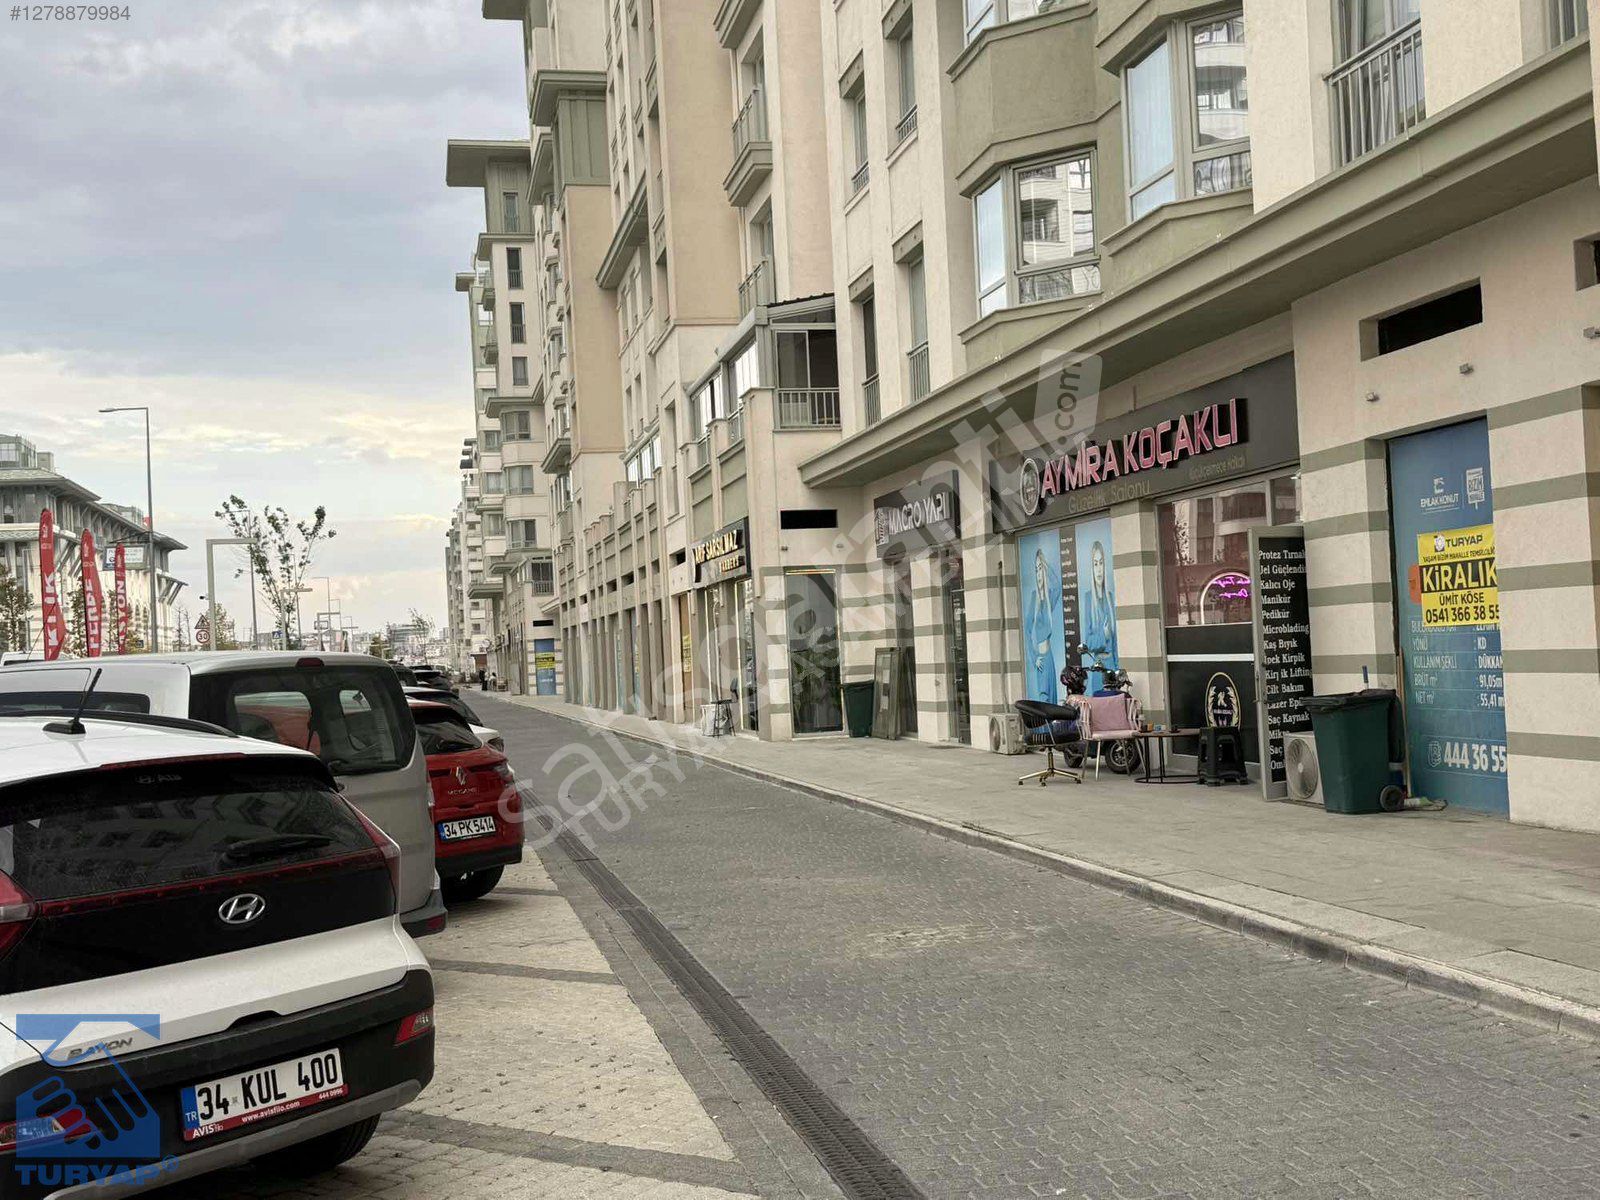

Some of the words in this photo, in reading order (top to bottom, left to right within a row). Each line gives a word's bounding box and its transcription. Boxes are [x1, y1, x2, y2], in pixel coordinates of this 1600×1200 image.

[1041, 440, 1119, 498] AYMİRA
[1123, 399, 1238, 474] KOÇAKLI
[888, 501, 922, 535] MACRO
[923, 492, 948, 524] YAPI
[1445, 535, 1482, 548] TURYAP
[1260, 564, 1270, 575] Jel
[1422, 560, 1498, 592] KİRALIK
[1282, 579, 1296, 591] Oje
[1261, 594, 1291, 605] Manikür
[1460, 591, 1485, 605] KÖSE
[1261, 609, 1290, 619] Pedikür
[1426, 607, 1449, 624] 0541
[1451, 606, 1471, 621] 366
[1473, 605, 1486, 620] 38
[1263, 623, 1310, 635] Microblading
[1282, 652, 1306, 665] Kirpik
[1444, 741, 1470, 769] 444
[1472, 744, 1489, 771] 36
[1491, 745, 1507, 773] 55
[444, 823, 457, 838] 34
[458, 820, 473, 834] PK
[197, 1082, 230, 1120] 34
[241, 1069, 287, 1110] KUL
[298, 1053, 338, 1092] 400
[185, 1110, 198, 1123] TR
[192, 1124, 215, 1139] AVIS
[241, 1100, 301, 1123] www.avisfilo.com
